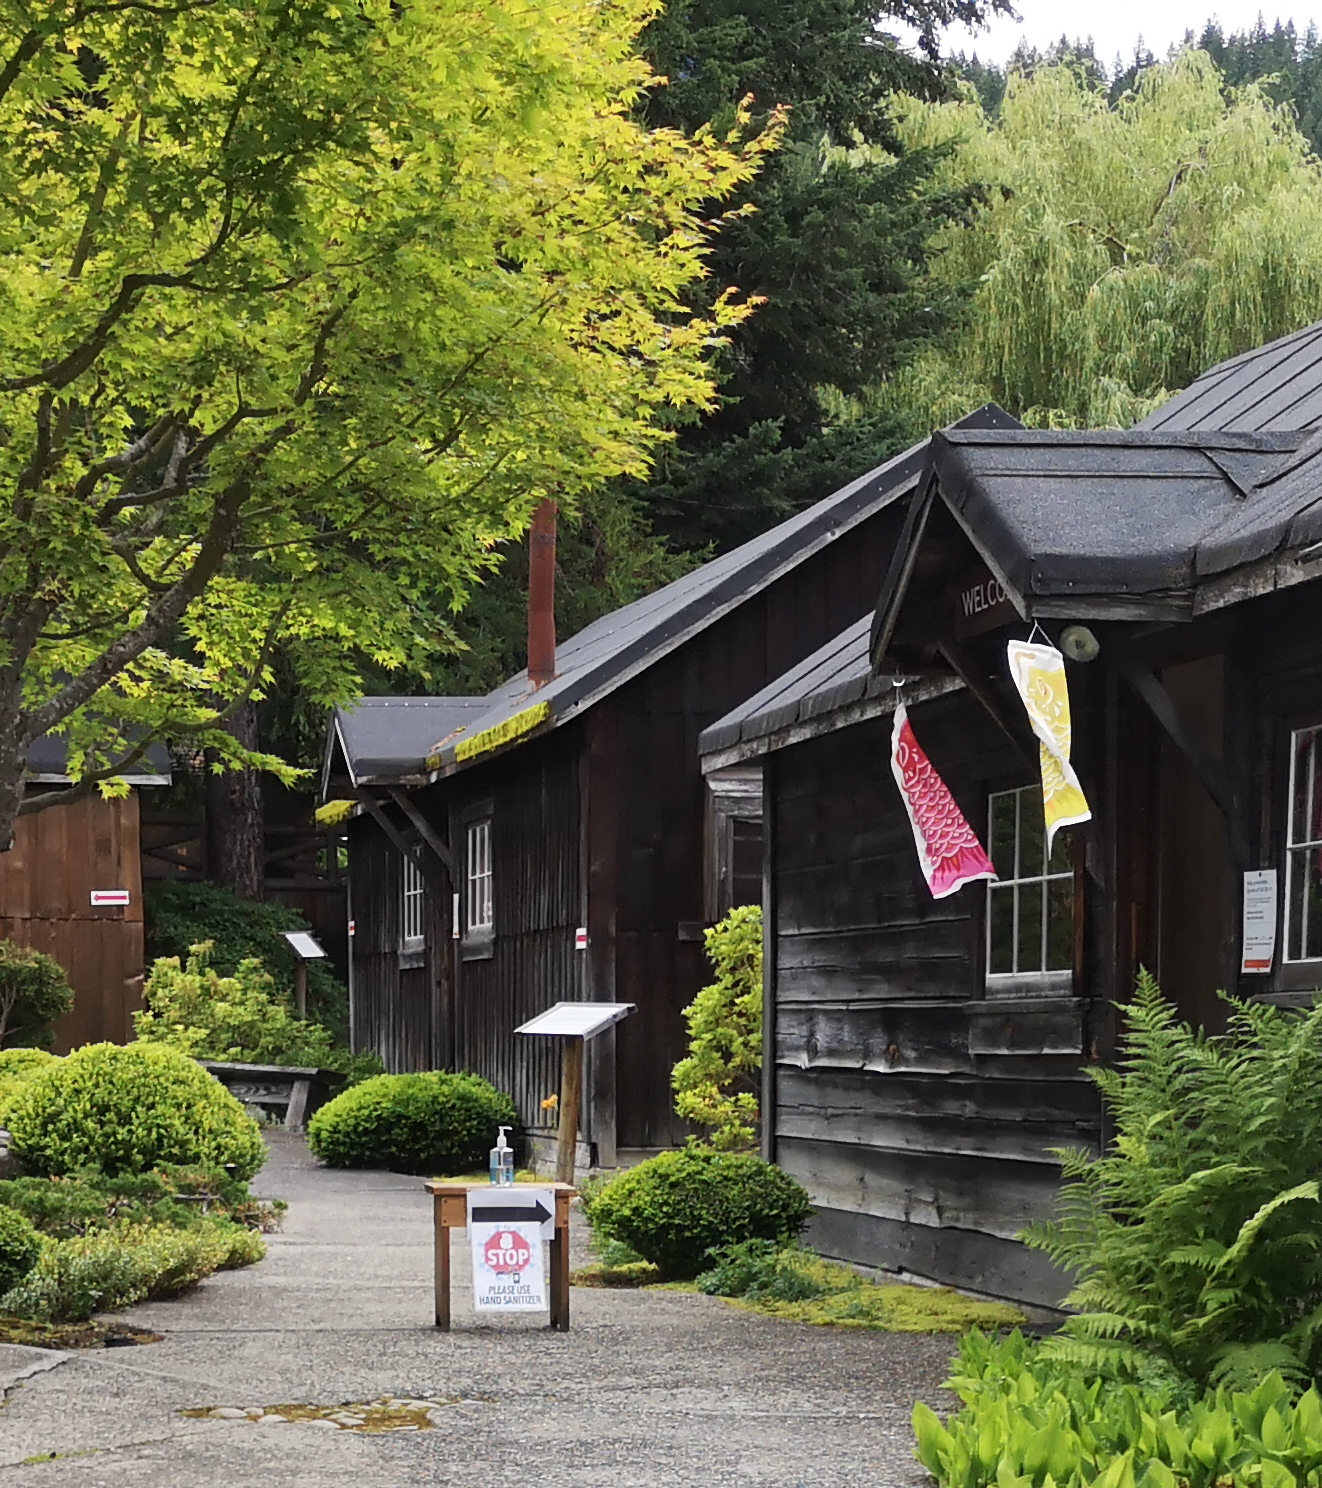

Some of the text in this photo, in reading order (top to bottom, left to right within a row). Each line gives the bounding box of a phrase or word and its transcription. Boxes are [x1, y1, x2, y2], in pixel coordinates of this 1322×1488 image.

[962, 580, 1008, 616] WELCO
[487, 1249, 529, 1267] STOP
[488, 1284, 531, 1295] PLEASE USE
[479, 1294, 542, 1306] HAND SANITIZER
